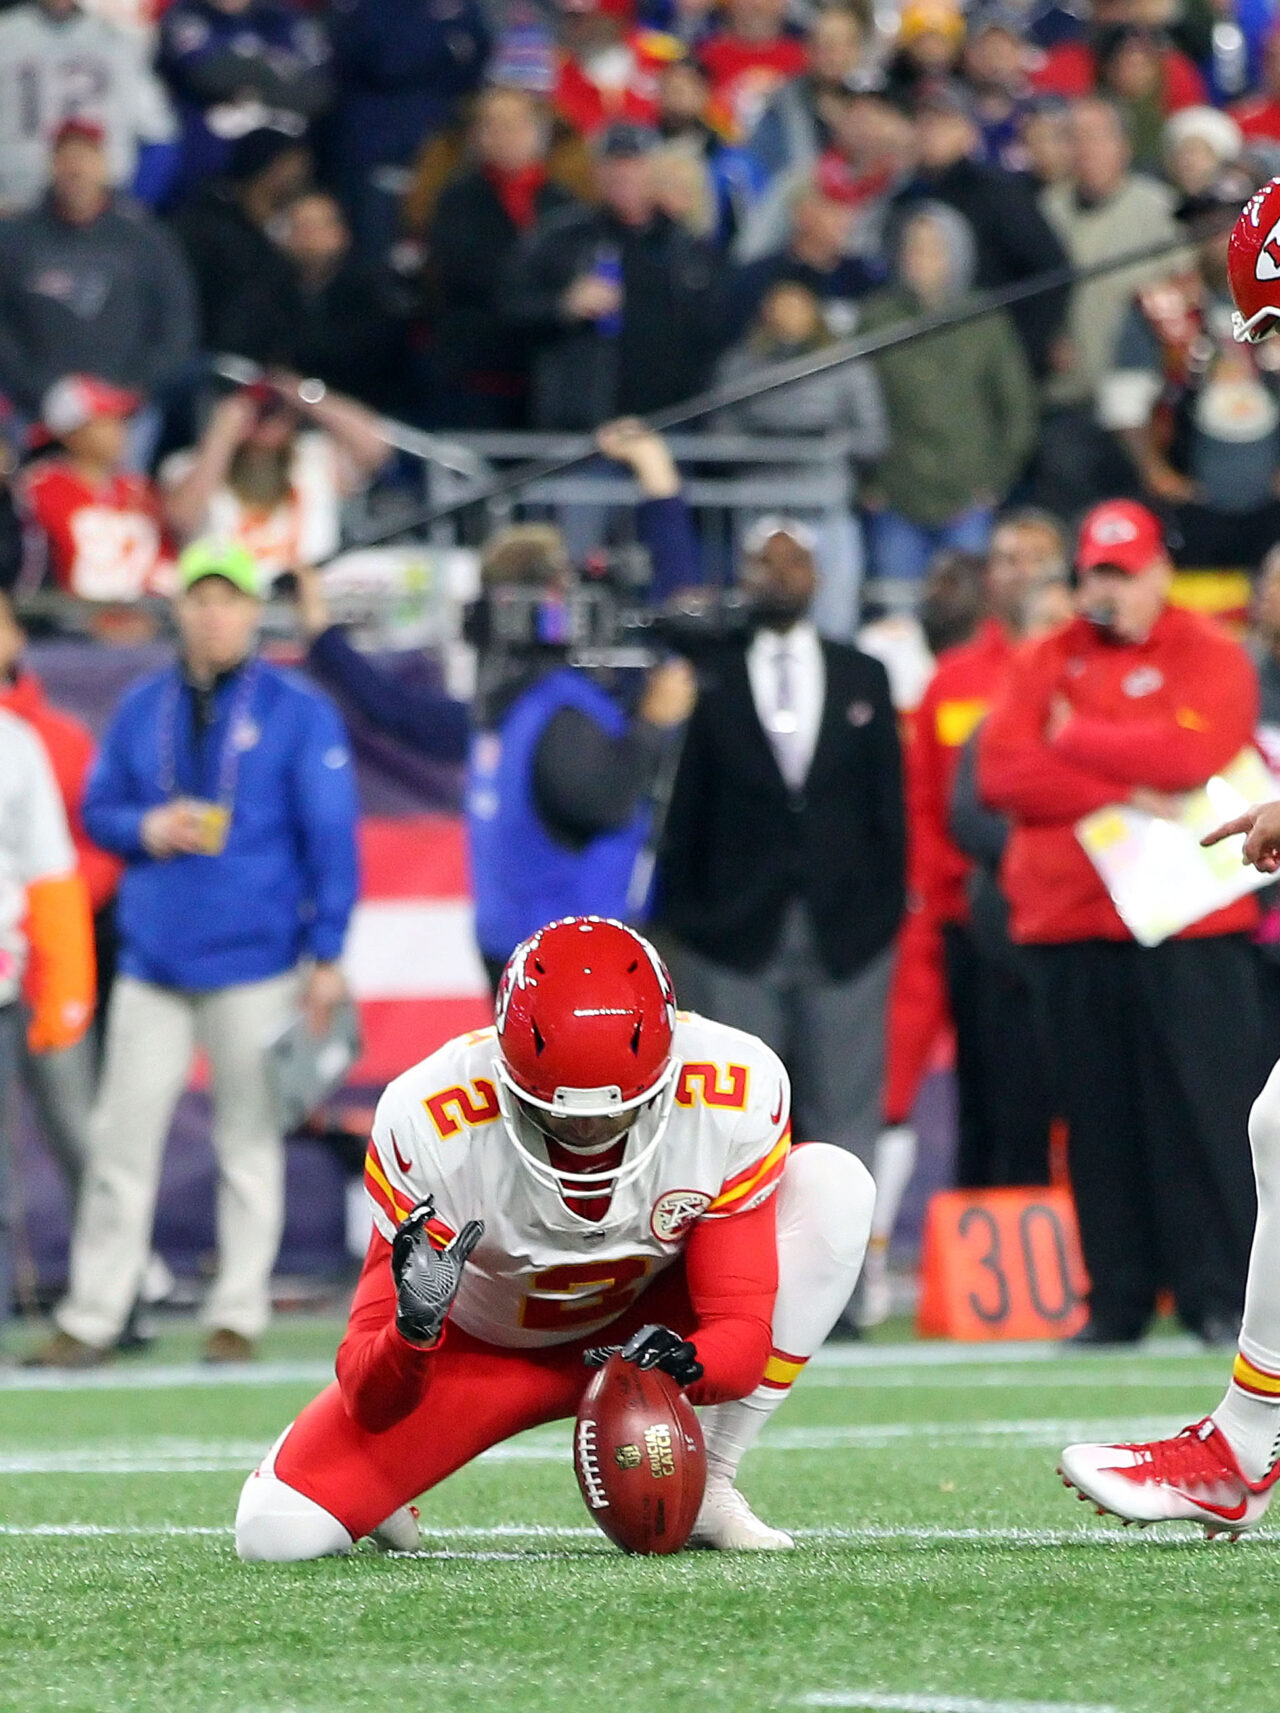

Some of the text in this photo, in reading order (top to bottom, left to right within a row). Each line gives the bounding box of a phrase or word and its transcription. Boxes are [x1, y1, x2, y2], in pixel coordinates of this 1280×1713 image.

[422, 1078, 501, 1141] 2
[674, 1061, 750, 1112] 2
[958, 1205, 1074, 1325] 30
[644, 1425, 663, 1479] CRUCIAL
[656, 1424, 675, 1476] CATCH
